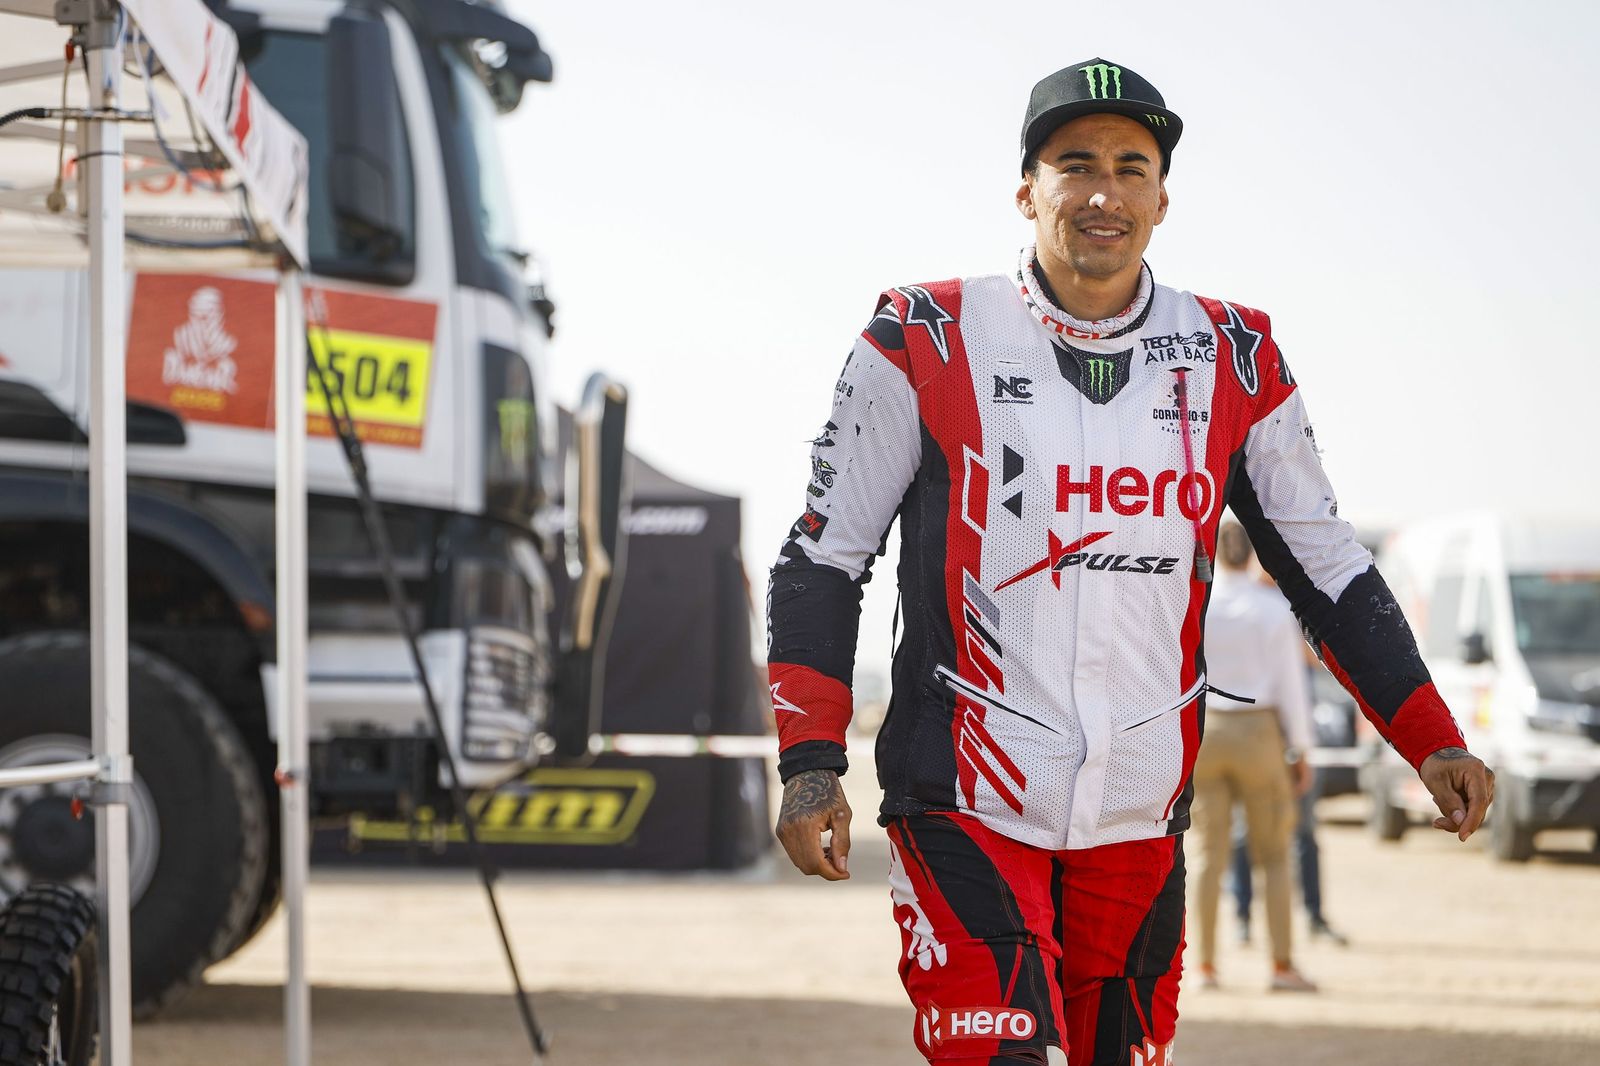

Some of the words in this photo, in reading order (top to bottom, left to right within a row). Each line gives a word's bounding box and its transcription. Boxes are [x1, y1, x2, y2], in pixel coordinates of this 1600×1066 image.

[1145, 347, 1178, 365] AIR
[1183, 346, 1216, 362] BAG
[993, 375, 1033, 399] NC
[1055, 464, 1212, 521] Hero
[951, 1010, 1033, 1037] Hero
